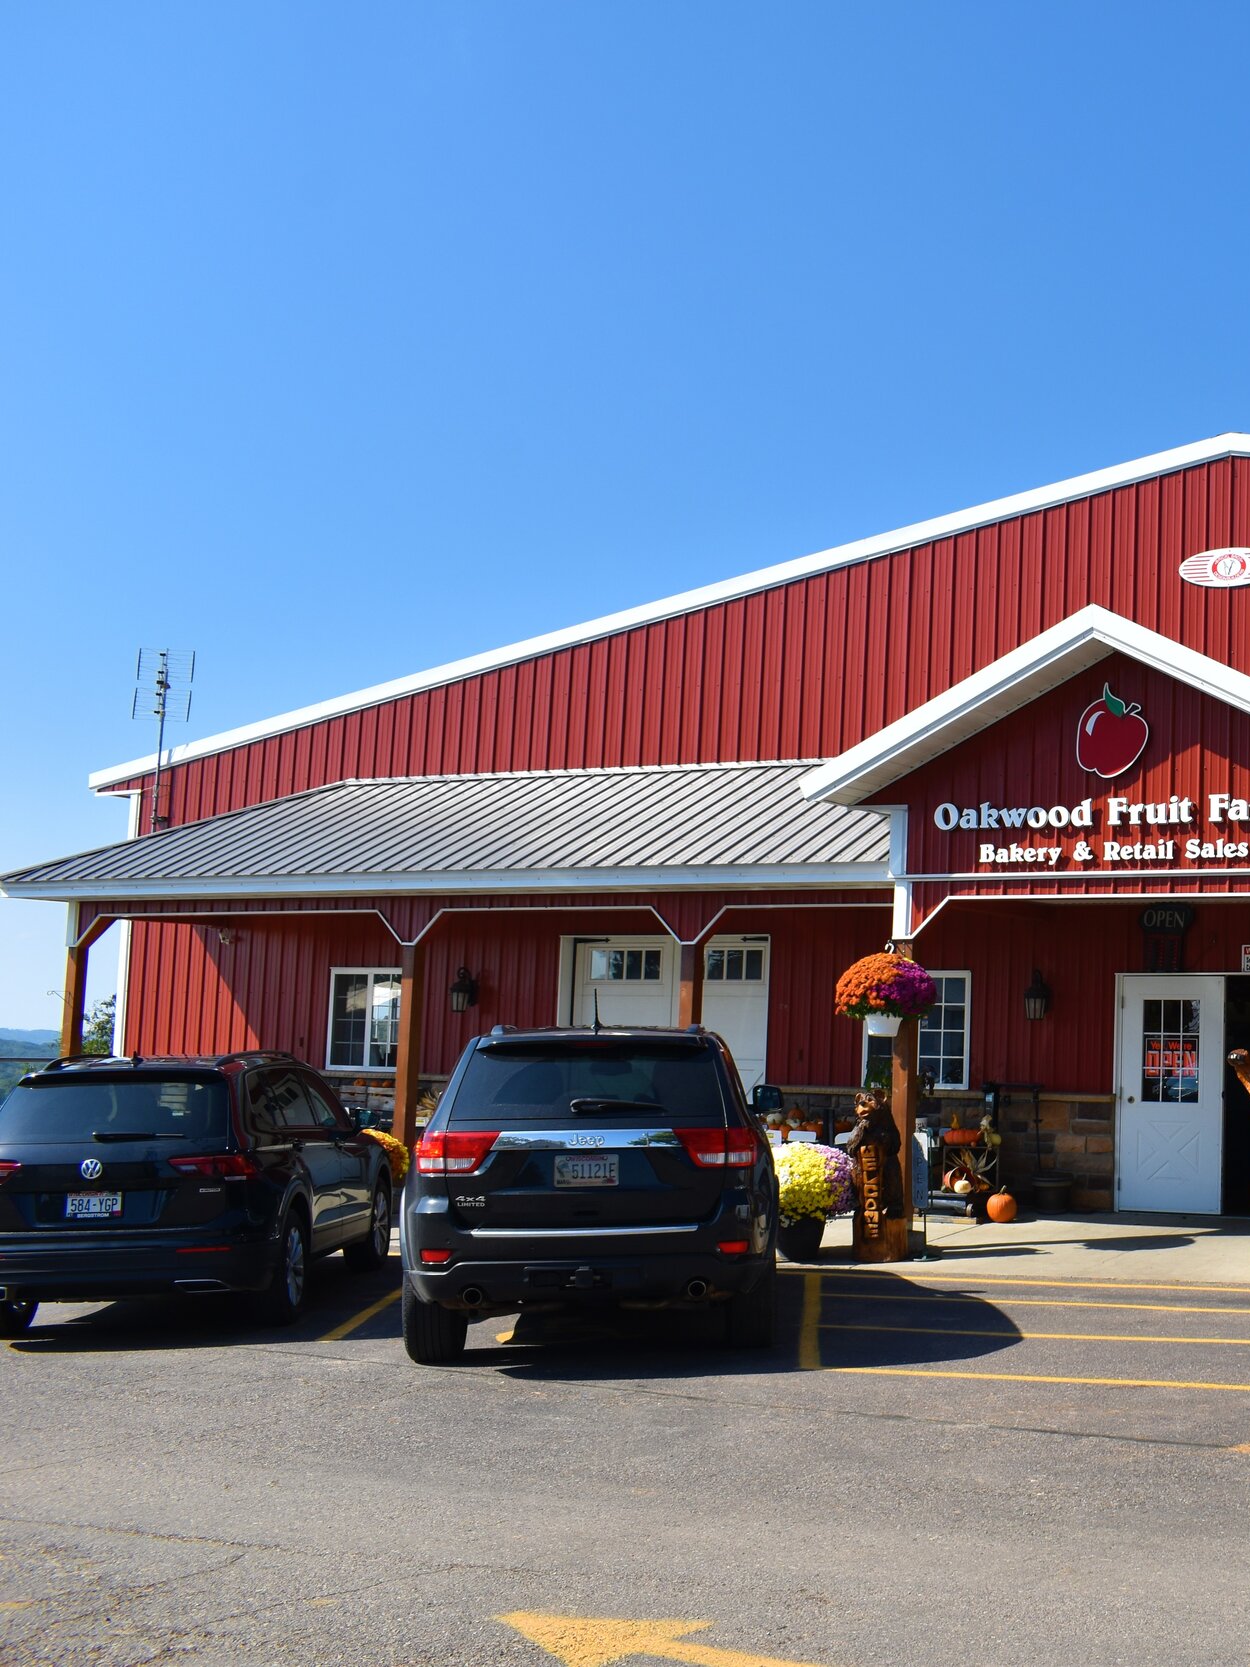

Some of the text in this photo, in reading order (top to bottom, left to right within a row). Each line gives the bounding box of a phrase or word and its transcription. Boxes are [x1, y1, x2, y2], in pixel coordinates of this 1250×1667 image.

[933, 798, 1093, 831] Oakwood
[1107, 795, 1193, 825] Fruit
[979, 838, 1249, 865] Bakery & Retail Sales
[1143, 909, 1186, 929] OPEN
[1146, 1051, 1197, 1077] OPEN
[569, 1133, 606, 1147] Jeep
[572, 1163, 616, 1179] 51121E
[70, 1198, 118, 1212] 584-YGP
